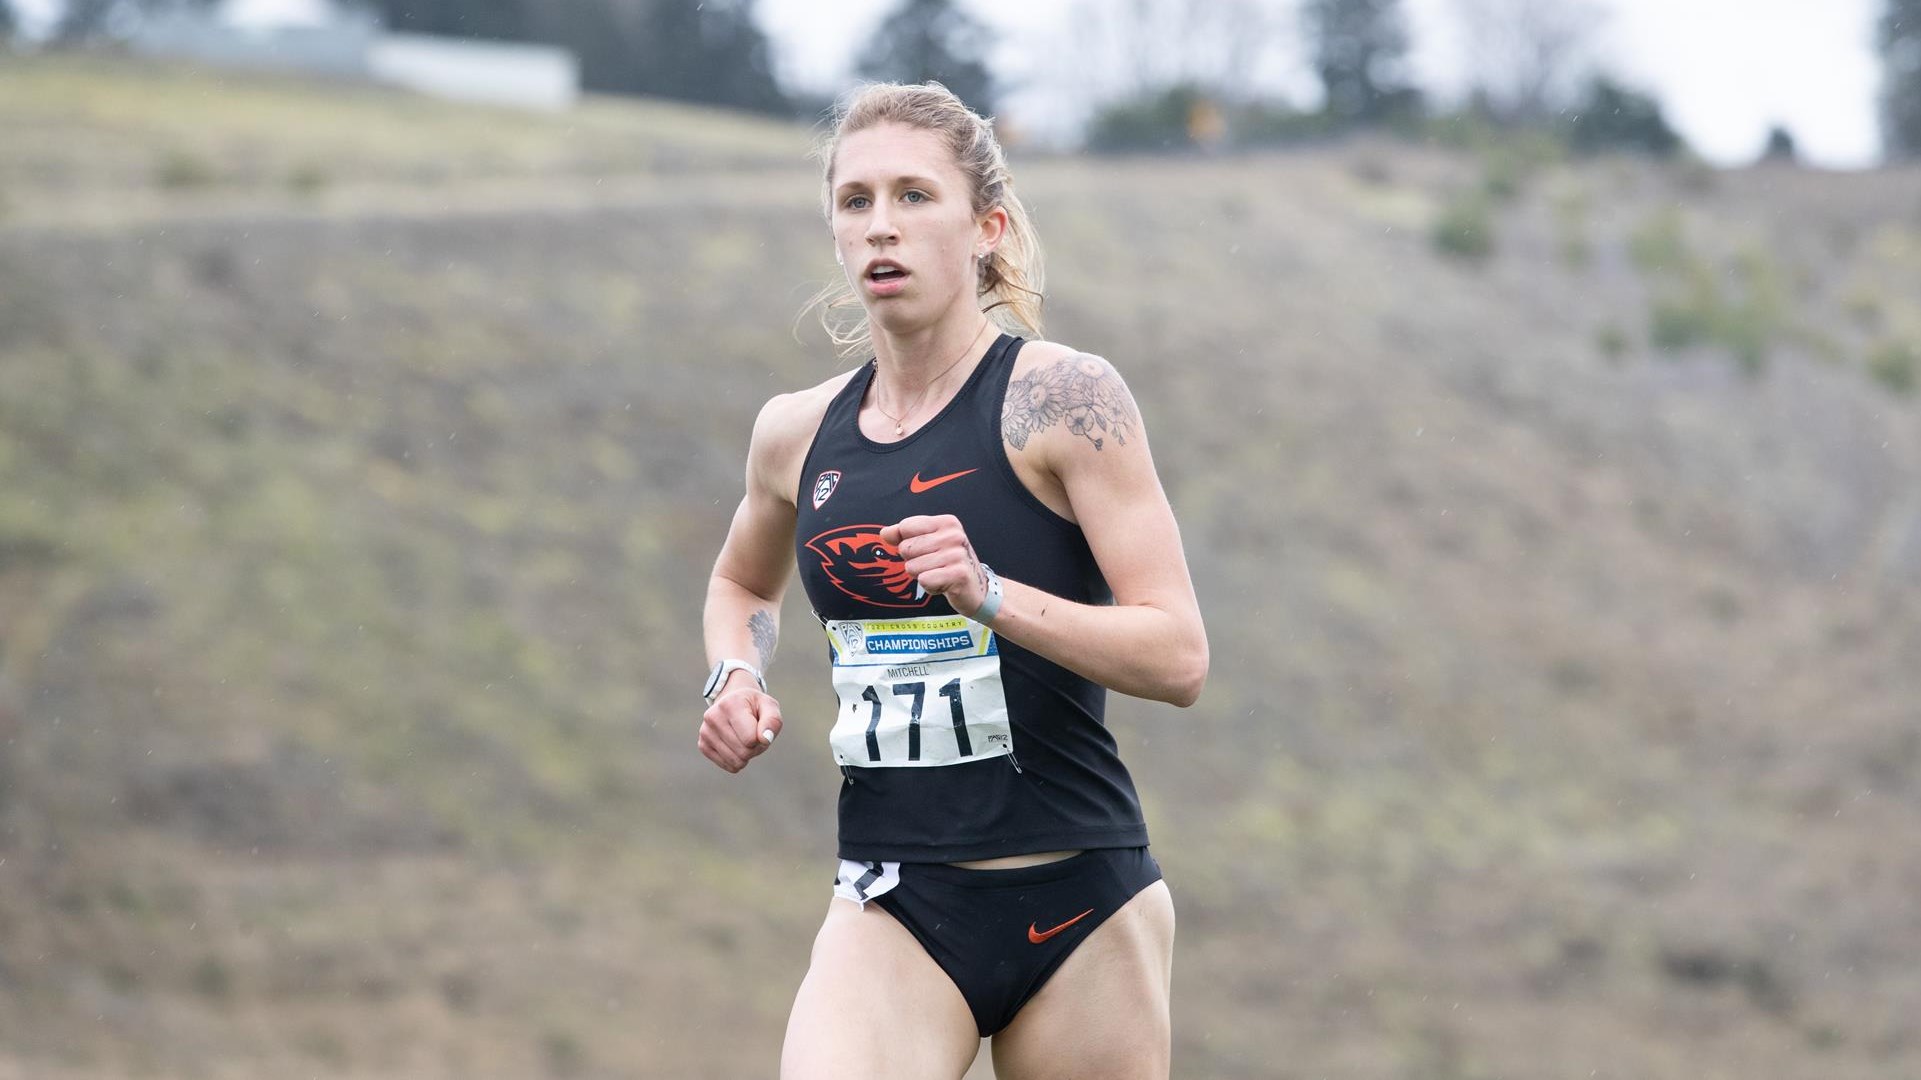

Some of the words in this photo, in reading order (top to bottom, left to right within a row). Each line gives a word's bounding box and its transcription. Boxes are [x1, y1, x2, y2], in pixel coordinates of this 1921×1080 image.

[890, 622, 918, 630] CROSS
[922, 621, 963, 629] COUNTRY
[867, 635, 971, 651] CHAMPIONSHIPS
[887, 665, 930, 678] MITCHELL
[861, 677, 974, 762] 171
